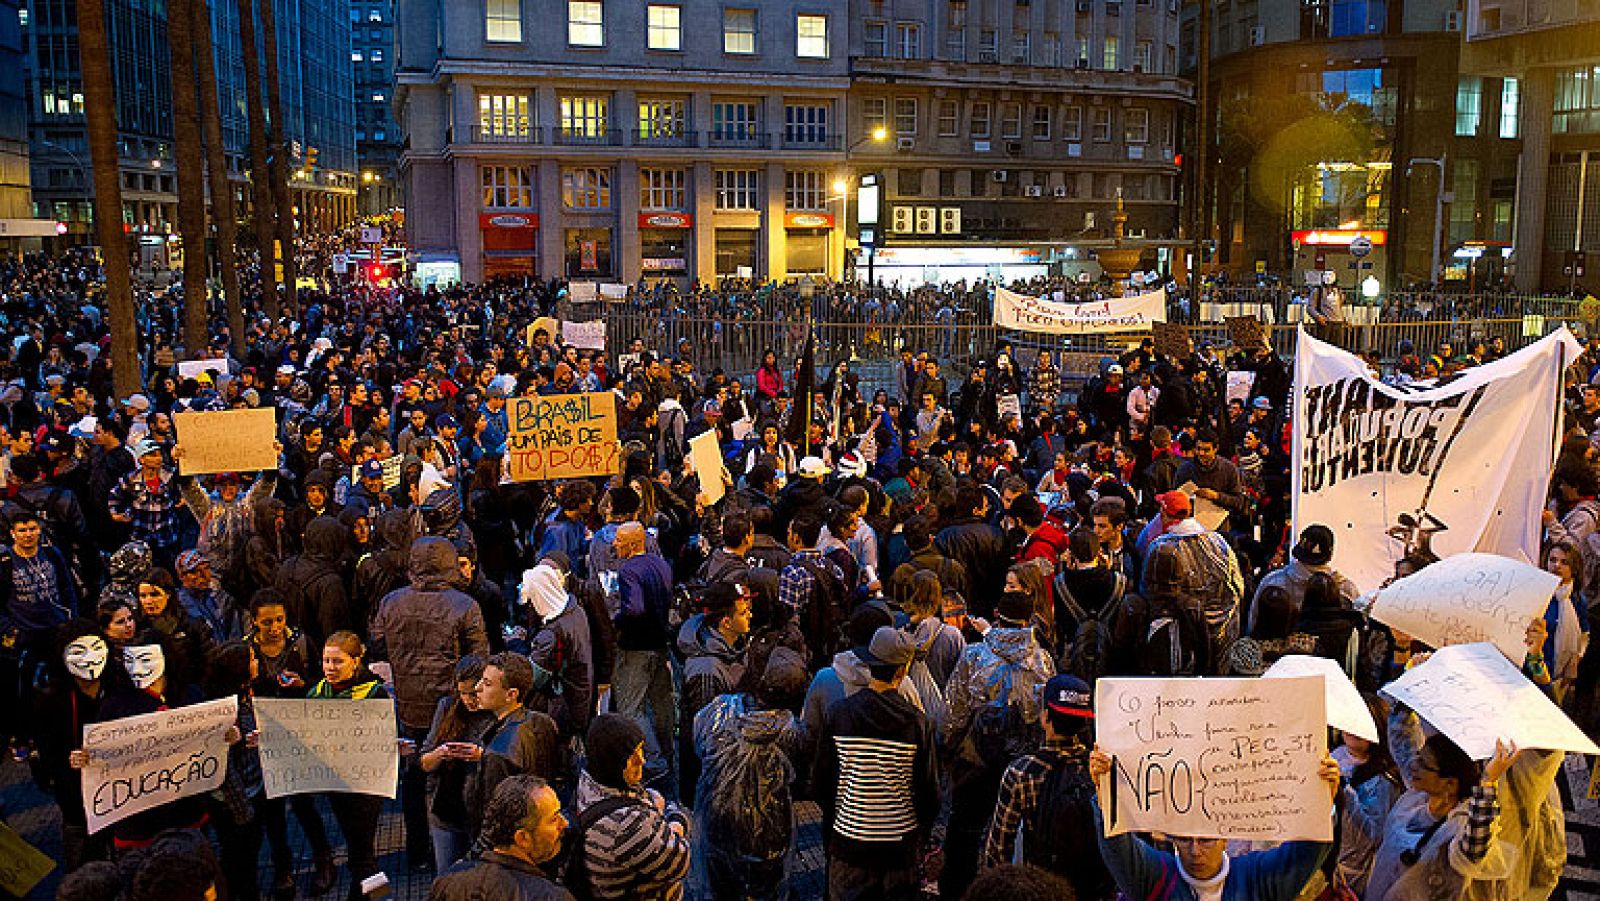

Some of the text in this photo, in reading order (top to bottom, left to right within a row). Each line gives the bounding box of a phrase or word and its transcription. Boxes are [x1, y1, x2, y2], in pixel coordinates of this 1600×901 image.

[510, 434, 538, 449] UM
[579, 427, 602, 444] DE
[86, 721, 159, 745] ESTAMOS
[1229, 736, 1278, 760] PEC
[93, 750, 218, 816] EDUCAÇÃO
[1110, 747, 1192, 831] NÃO
